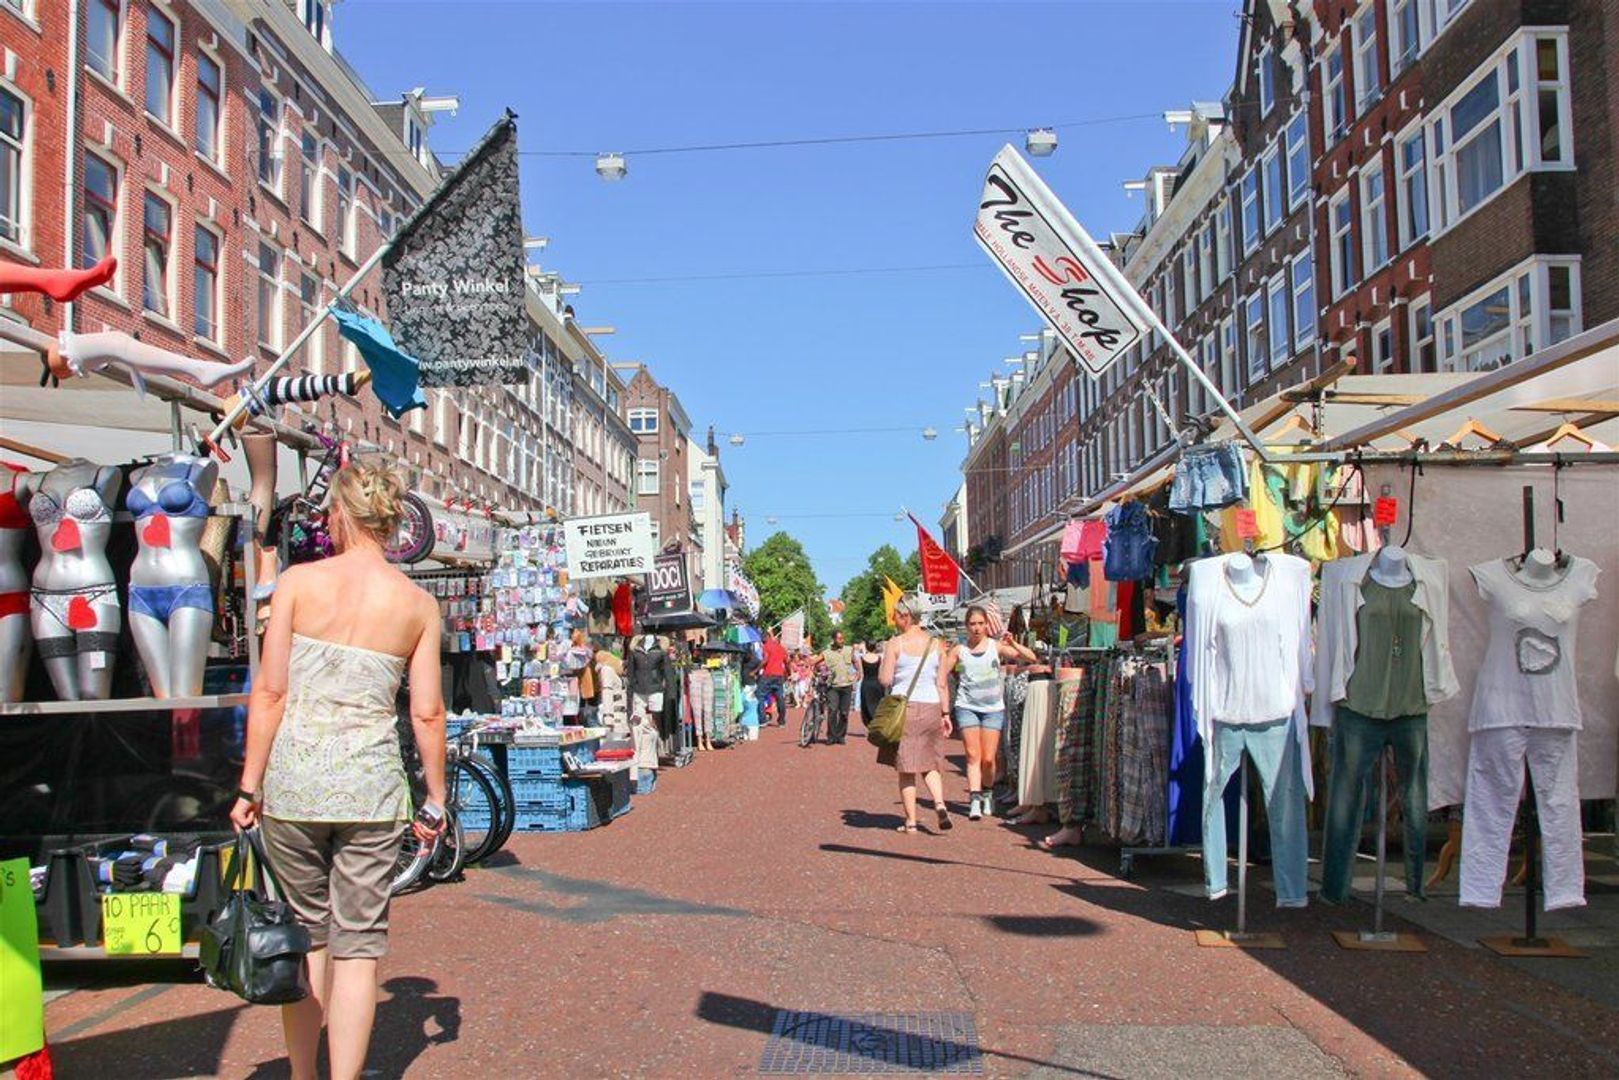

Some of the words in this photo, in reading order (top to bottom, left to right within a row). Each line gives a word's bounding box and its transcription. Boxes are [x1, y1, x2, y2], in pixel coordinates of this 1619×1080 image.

[981, 174, 1035, 249] The
[1031, 256, 1120, 351] Shop
[402, 282, 448, 298] Panty
[453, 278, 509, 294] Winkel
[1029, 283, 1049, 309] MATEN
[577, 521, 633, 536] FIETSEN
[586, 538, 617, 548] NIEUW
[580, 556, 645, 573] REPARATIES
[104, 896, 122, 918] 10
[129, 893, 170, 918] PAAR
